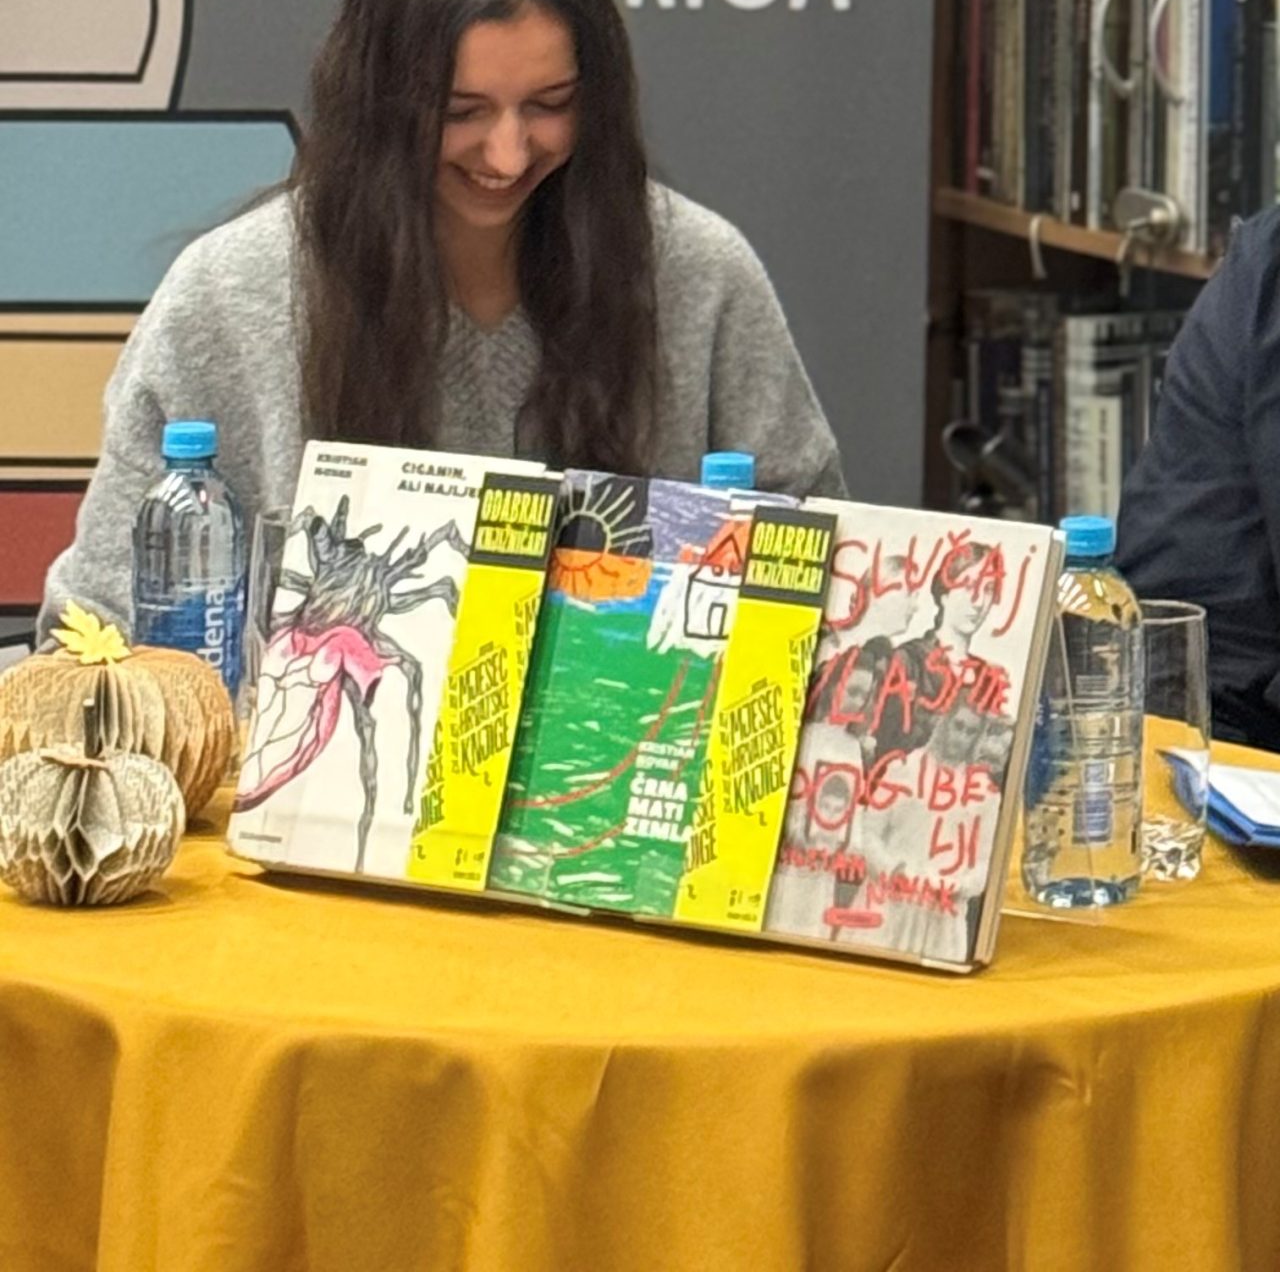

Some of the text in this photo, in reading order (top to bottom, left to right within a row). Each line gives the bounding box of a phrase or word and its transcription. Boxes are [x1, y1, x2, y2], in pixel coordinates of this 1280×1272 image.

[397, 480, 421, 492] ALI
[480, 489, 554, 527] ODABRALI
[475, 524, 549, 557] KNJIŽNIČARI
[751, 521, 830, 563] ODABRALI
[747, 557, 823, 595] KNJIŽNIČARI
[458, 647, 508, 708] MJESEC
[728, 684, 784, 744] MJESEC
[460, 712, 510, 777] KNJIGE
[730, 719, 785, 773] HRVATSKE
[630, 771, 688, 801] ČRNA
[733, 748, 787, 816] KNJIGE
[627, 796, 684, 822] MATI
